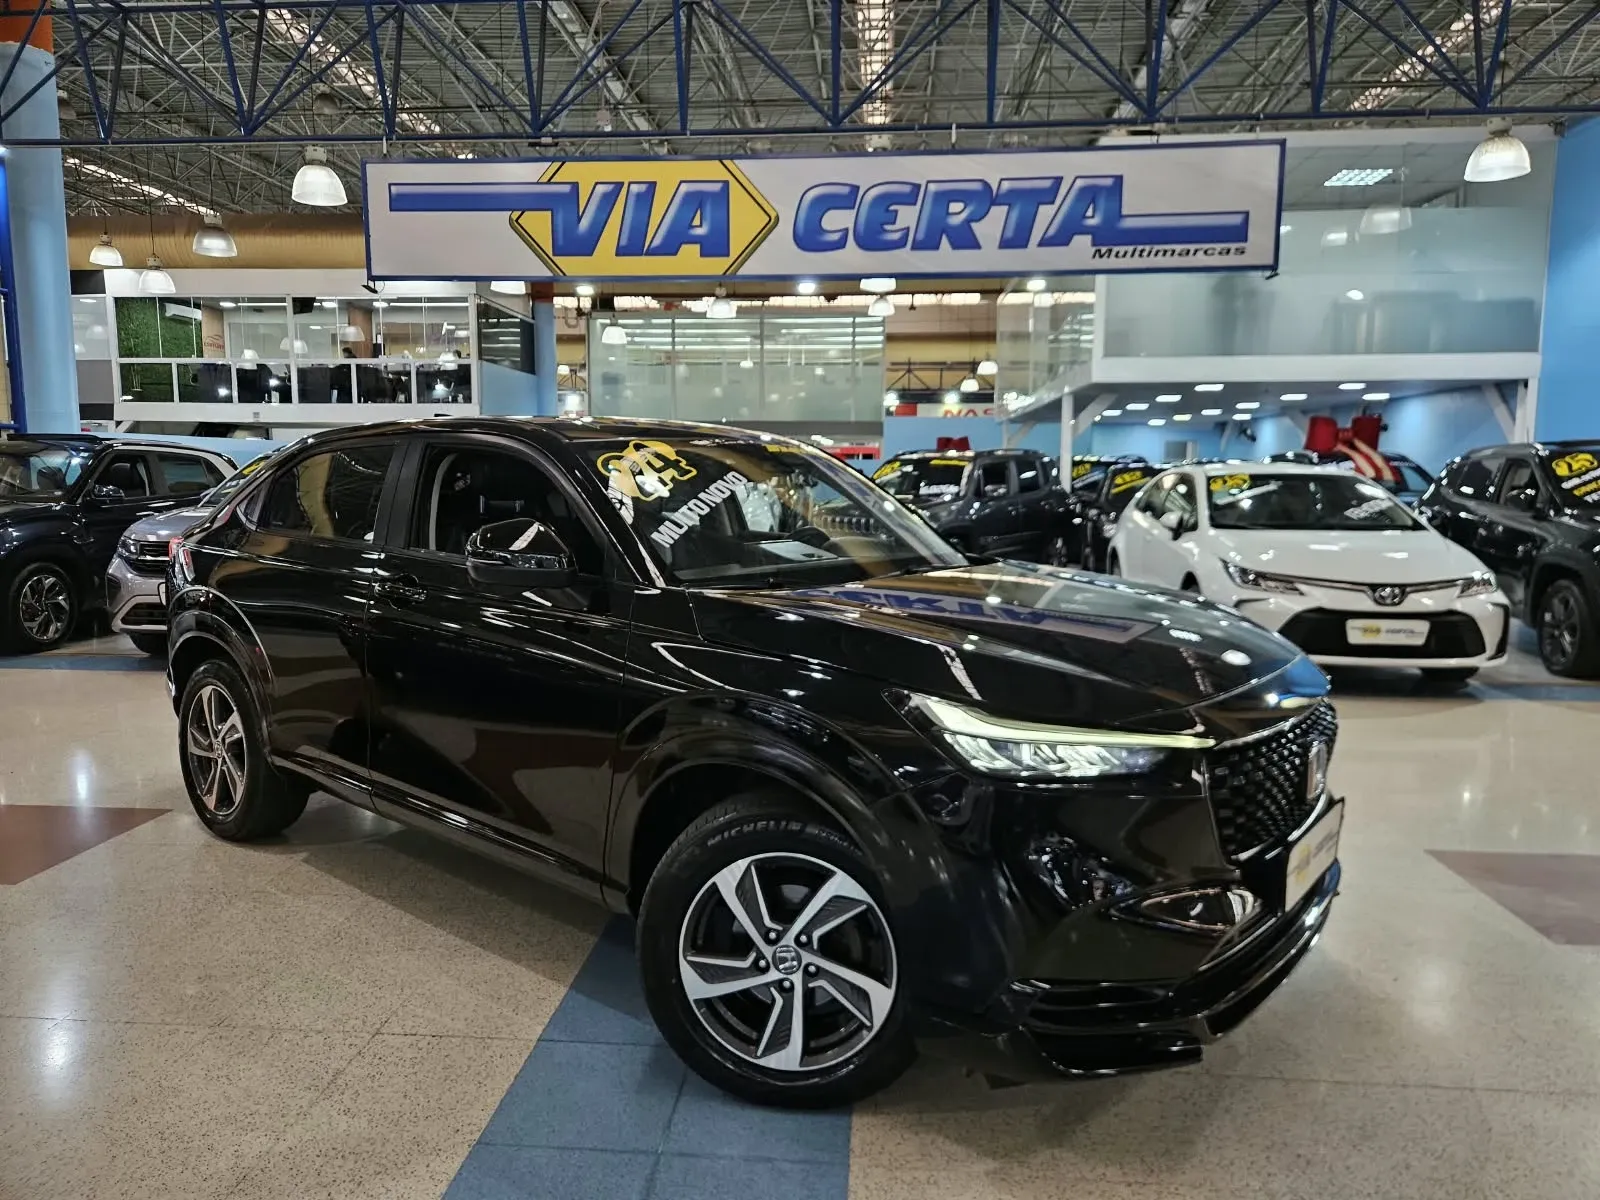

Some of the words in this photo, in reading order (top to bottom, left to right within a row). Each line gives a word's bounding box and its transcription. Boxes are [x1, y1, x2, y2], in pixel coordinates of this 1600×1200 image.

[551, 180, 731, 257] VIA
[792, 175, 1124, 252] CERTA
[1092, 246, 1247, 260] Multimarcas
[650, 498, 711, 548] MUITO
[697, 470, 748, 507] NOVO
[707, 820, 803, 847] MICHELIN
